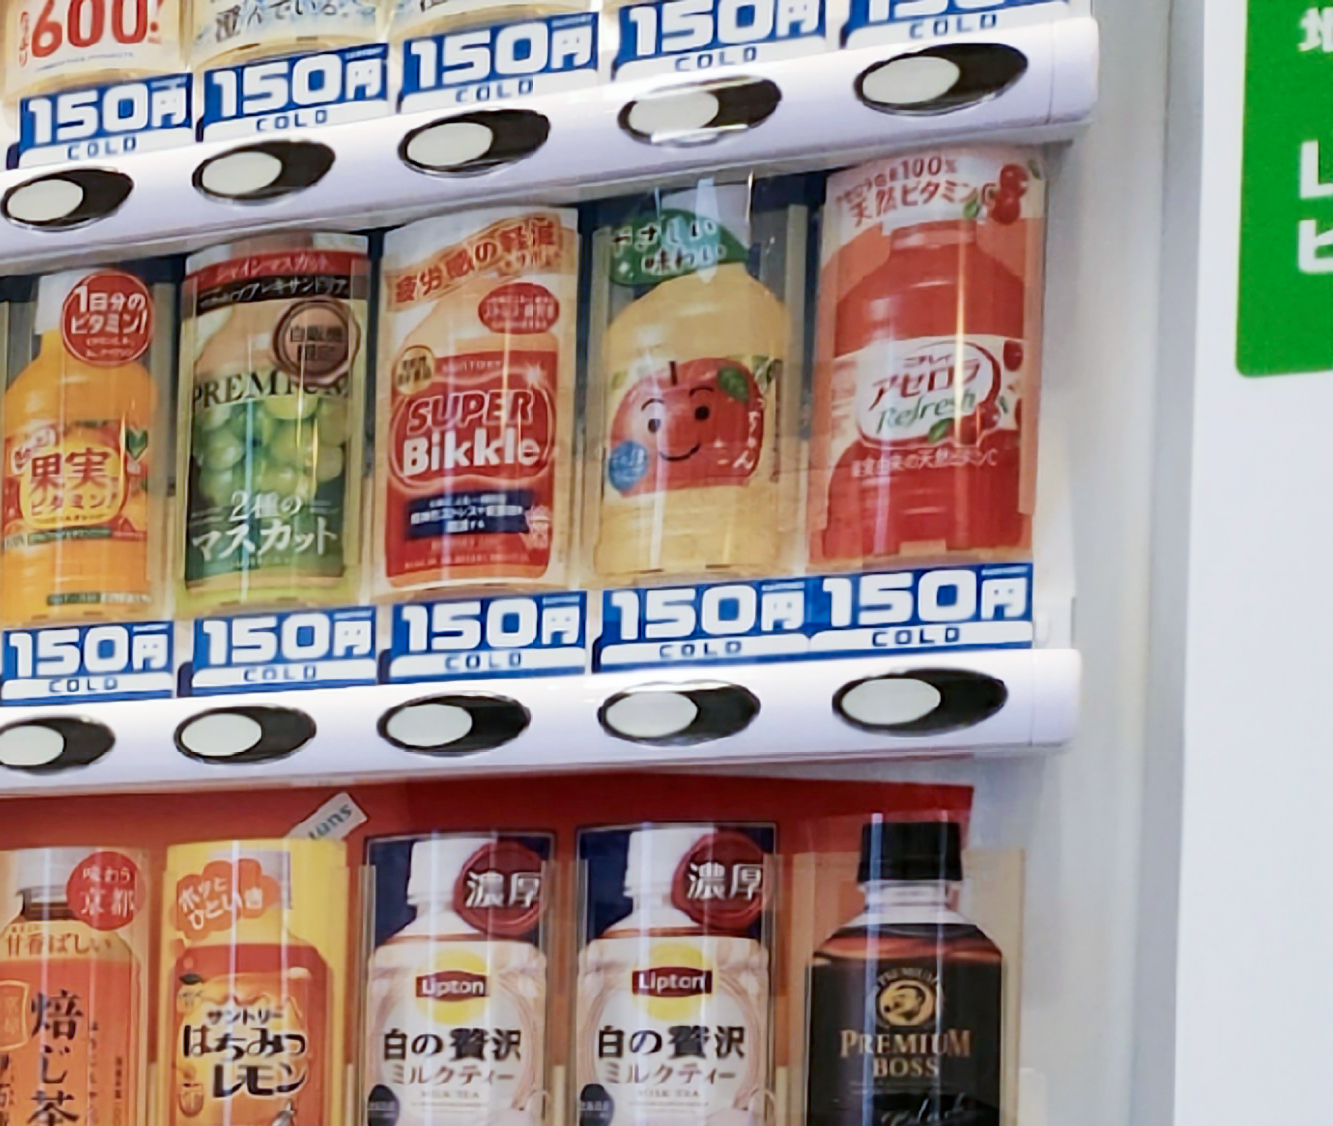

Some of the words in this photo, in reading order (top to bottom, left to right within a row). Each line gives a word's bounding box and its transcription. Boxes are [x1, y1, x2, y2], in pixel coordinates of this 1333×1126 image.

[909, 13, 997, 39] COLD
[410, 20, 593, 88] 150円
[675, 46, 758, 71] COLD
[213, 53, 386, 117] 150円
[455, 80, 534, 103] COLD
[28, 82, 187, 145] 150円
[256, 109, 328, 132] COLD
[67, 135, 137, 161] COLD
[74, 284, 146, 314] 1日分の
[869, 358, 981, 412] アセロラ
[406, 389, 533, 435] SUPER
[877, 389, 976, 435] Refresh
[31, 446, 112, 490] 果実
[402, 428, 541, 477] Bikkle
[192, 519, 338, 562] マスカット
[612, 585, 806, 640] 150円
[822, 570, 1028, 628] 150円
[203, 613, 372, 665] 150円
[402, 599, 580, 652] 150円
[872, 627, 961, 648] COLD
[9, 624, 168, 677] 150円
[444, 651, 522, 670] COLD
[659, 640, 743, 659] COLD
[48, 676, 118, 694] COLD
[243, 664, 317, 682] COLD
[82, 866, 131, 883] 味わう
[464, 870, 543, 908] 濃厚
[686, 862, 765, 900] 濃厚
[79, 888, 135, 916] 京都
[419, 975, 486, 998] Lipton
[638, 971, 707, 994] Lipton
[206, 1007, 285, 1025] サントリー
[182, 1025, 306, 1062] はちみつ
[383, 1027, 522, 1062] 白の贅沢
[597, 1025, 746, 1060] 白の贅沢
[839, 1028, 972, 1058] PREMIUM
[212, 1062, 307, 1098] レモン
[389, 1064, 516, 1087] ミルクティー
[604, 1063, 737, 1086] ミルクティー
[872, 1057, 940, 1078] BOSS
